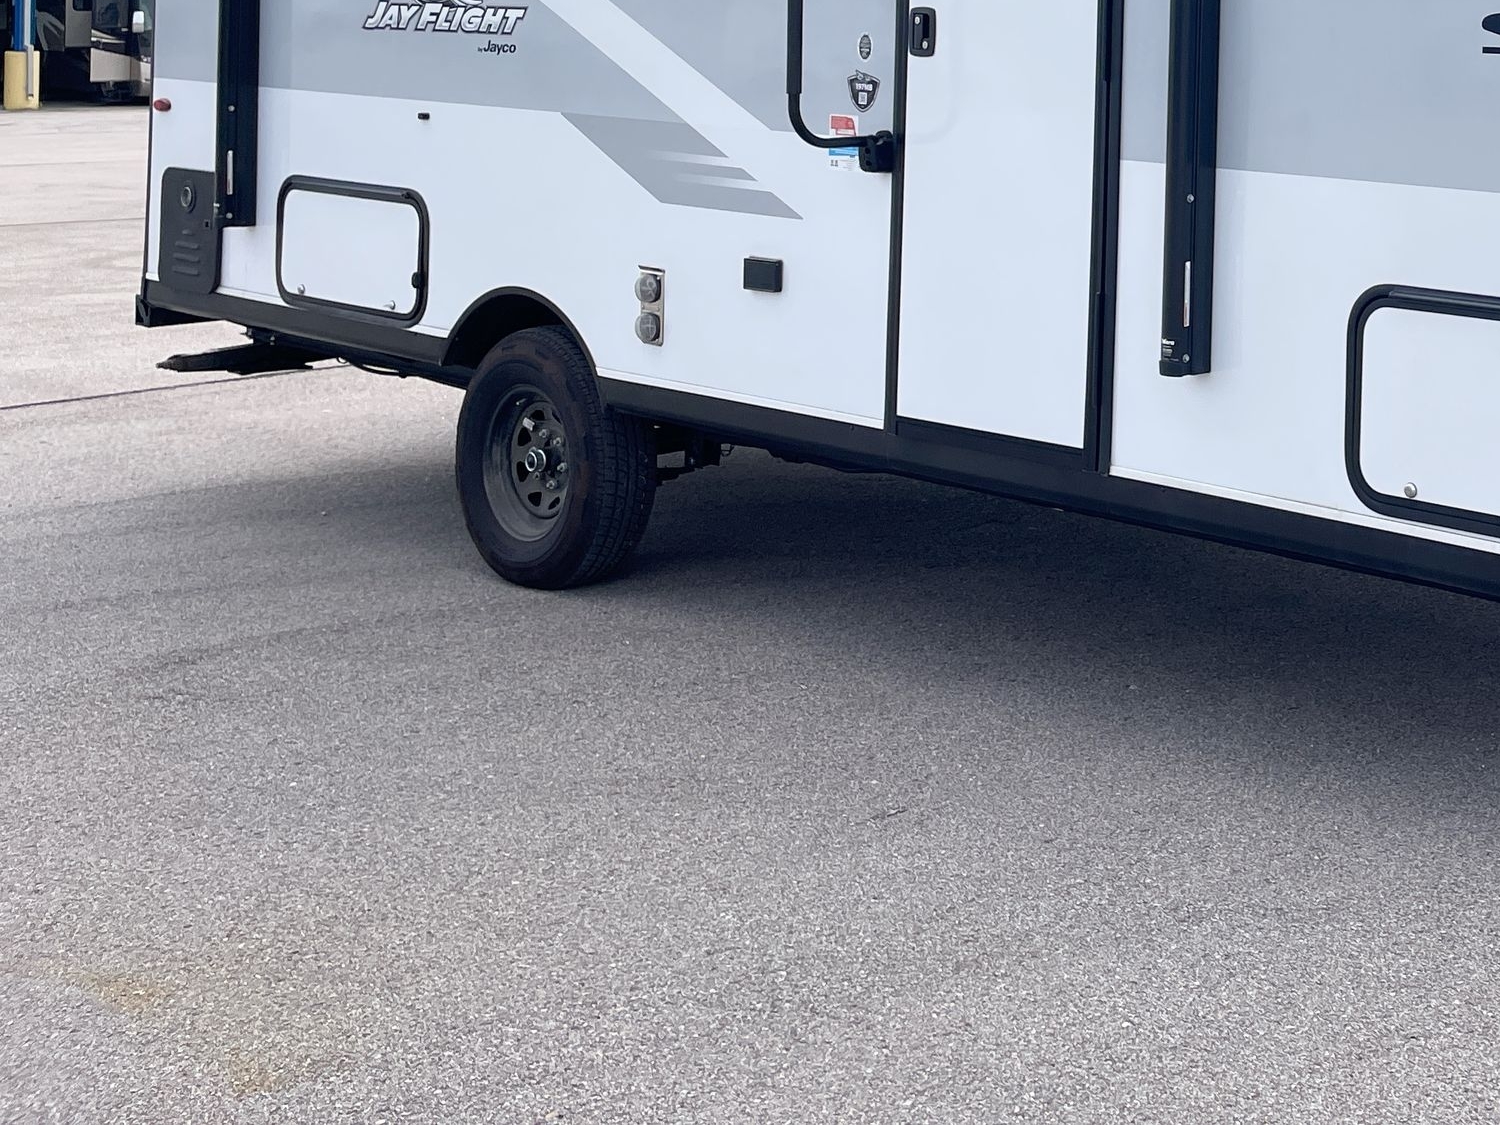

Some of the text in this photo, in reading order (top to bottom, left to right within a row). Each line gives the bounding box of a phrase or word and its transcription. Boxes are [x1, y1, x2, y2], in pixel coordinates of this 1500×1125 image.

[362, 0, 529, 36] JAY FLIGHT
[483, 39, 517, 56] Jayco
